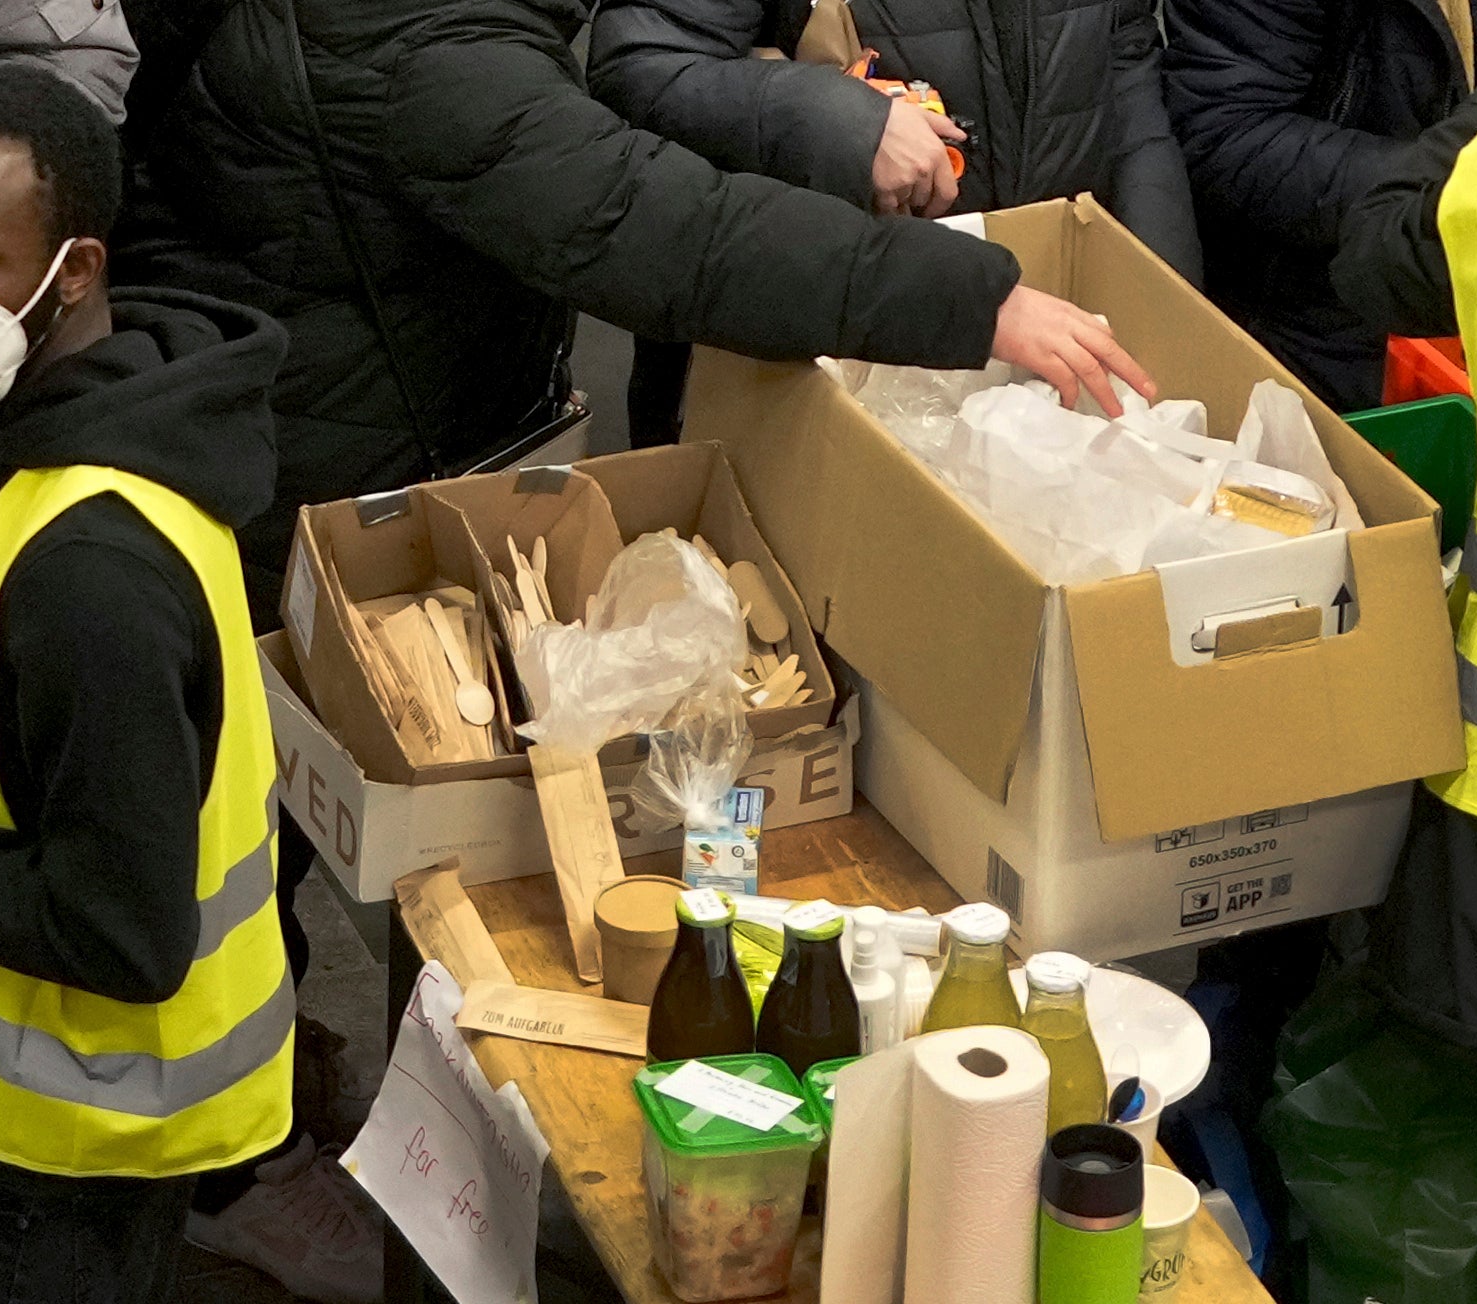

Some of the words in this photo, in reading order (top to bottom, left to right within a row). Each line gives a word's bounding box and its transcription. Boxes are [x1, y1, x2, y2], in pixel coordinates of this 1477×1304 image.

[1188, 838, 1278, 869] 650x350x370
[1226, 881, 1244, 894] GET
[1247, 877, 1264, 889] THE
[1225, 891, 1263, 914] APP
[481, 1010, 505, 1024] ZUM
